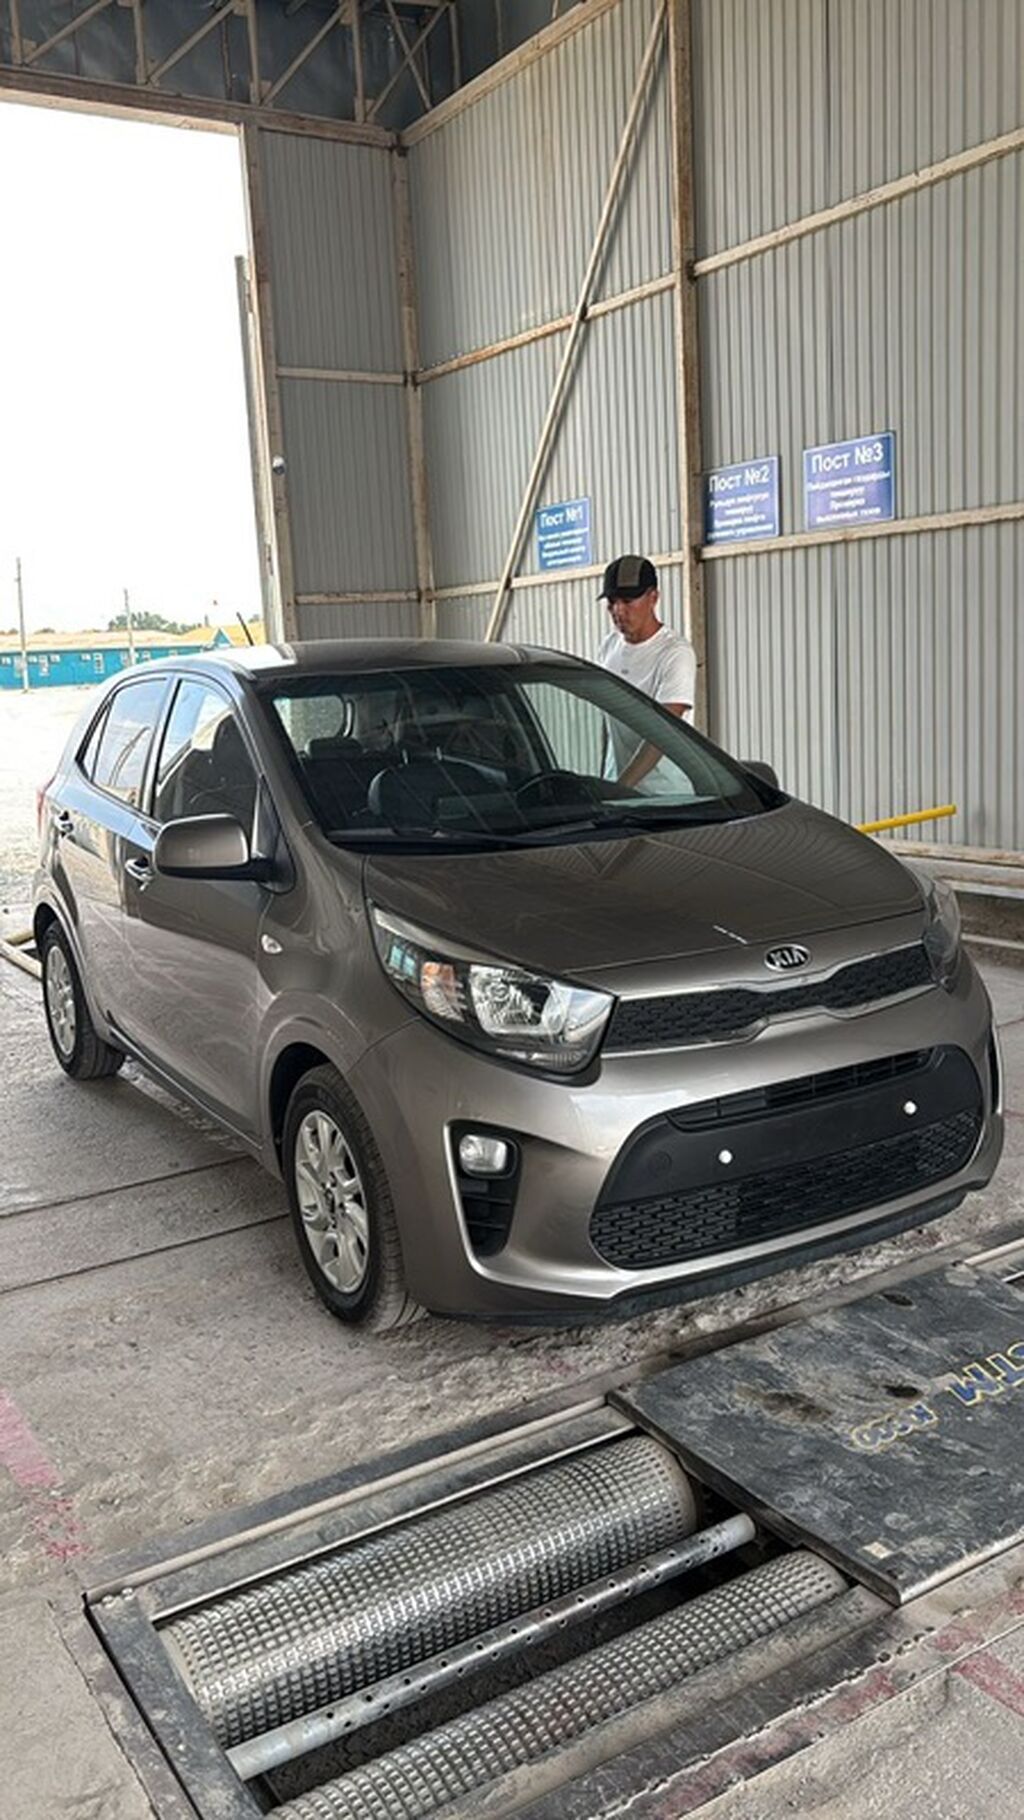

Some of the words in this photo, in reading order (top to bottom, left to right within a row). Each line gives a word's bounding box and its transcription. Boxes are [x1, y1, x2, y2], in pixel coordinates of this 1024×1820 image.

[810, 452, 851, 474] Пост
[854, 441, 884, 465] №3
[709, 474, 742, 493] Пост
[744, 464, 770, 487] №2
[540, 512, 564, 529] Пост
[767, 946, 807, 968] KIA
